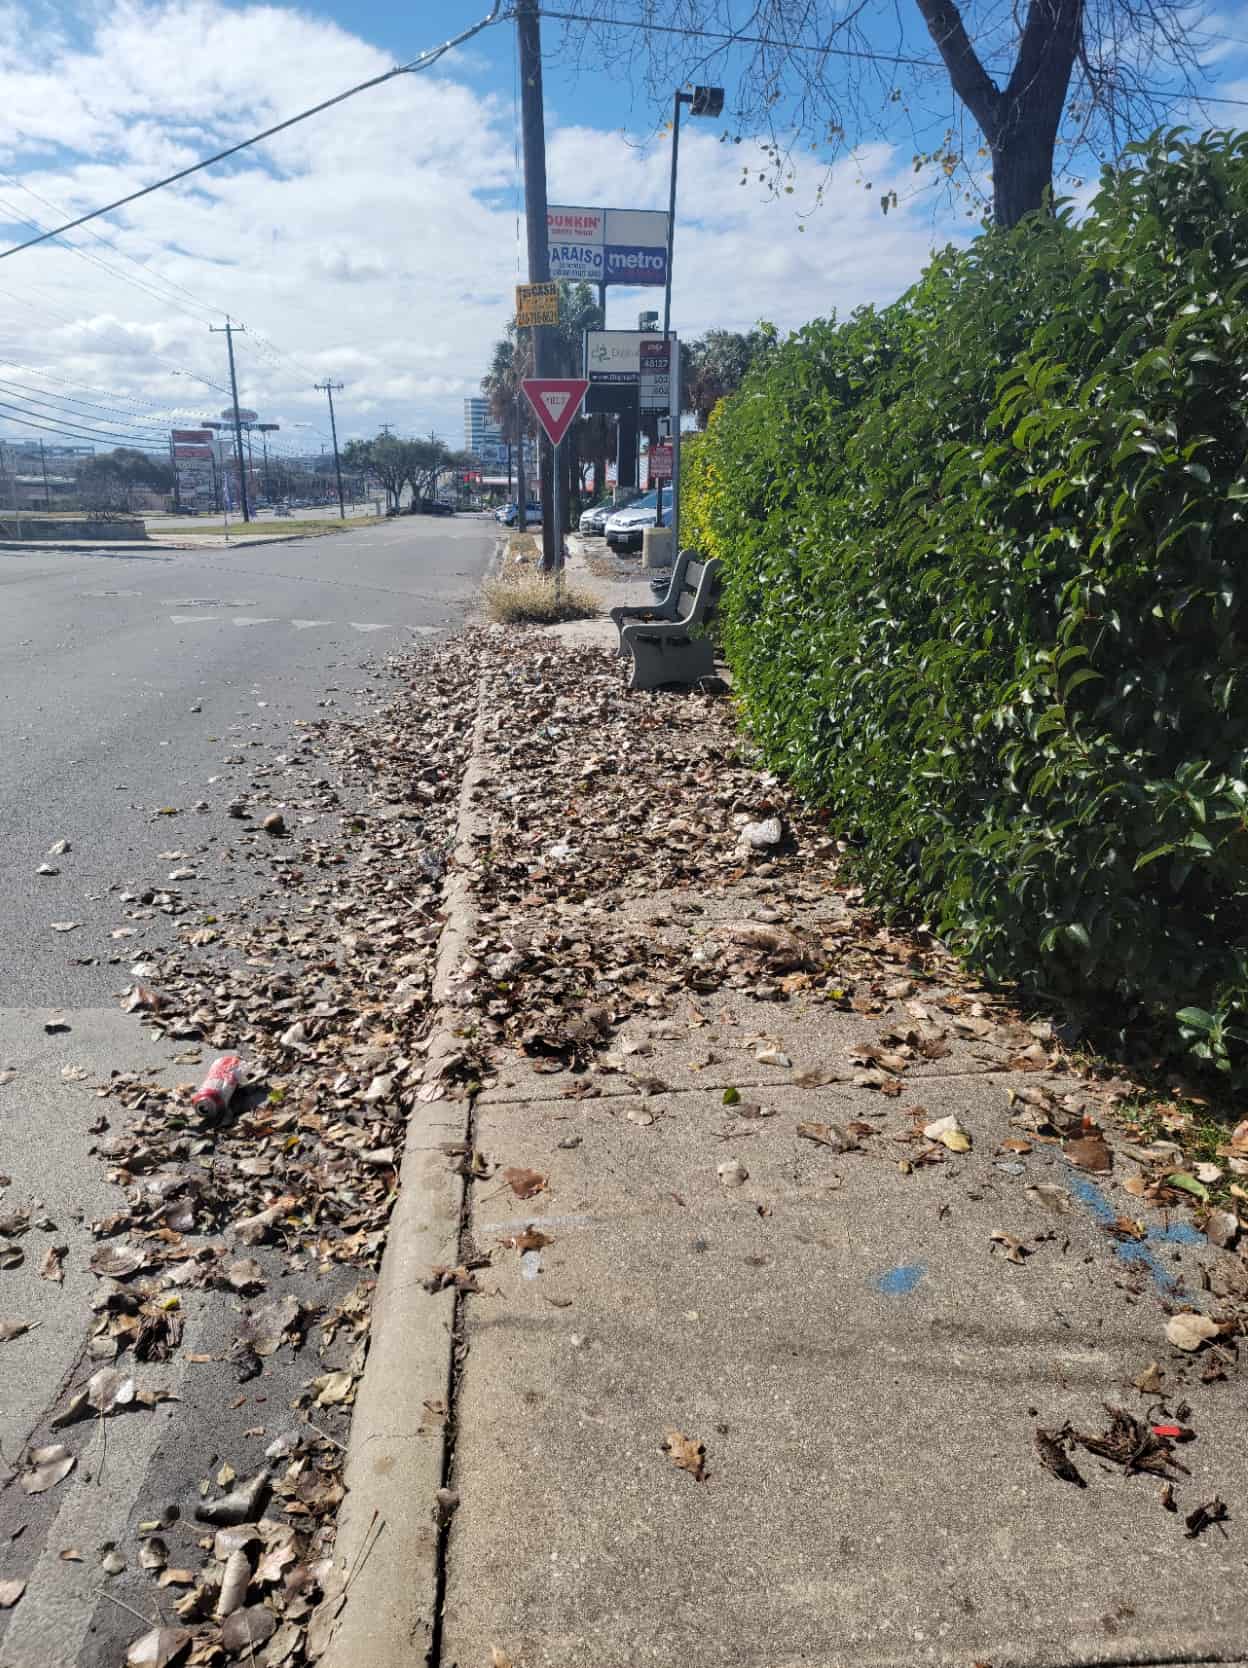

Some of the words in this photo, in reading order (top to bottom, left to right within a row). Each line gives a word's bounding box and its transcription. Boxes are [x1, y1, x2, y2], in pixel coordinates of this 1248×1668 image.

[546, 215, 600, 229] DUNKIN'
[548, 246, 602, 267] ARAISO
[608, 251, 663, 271] metro
